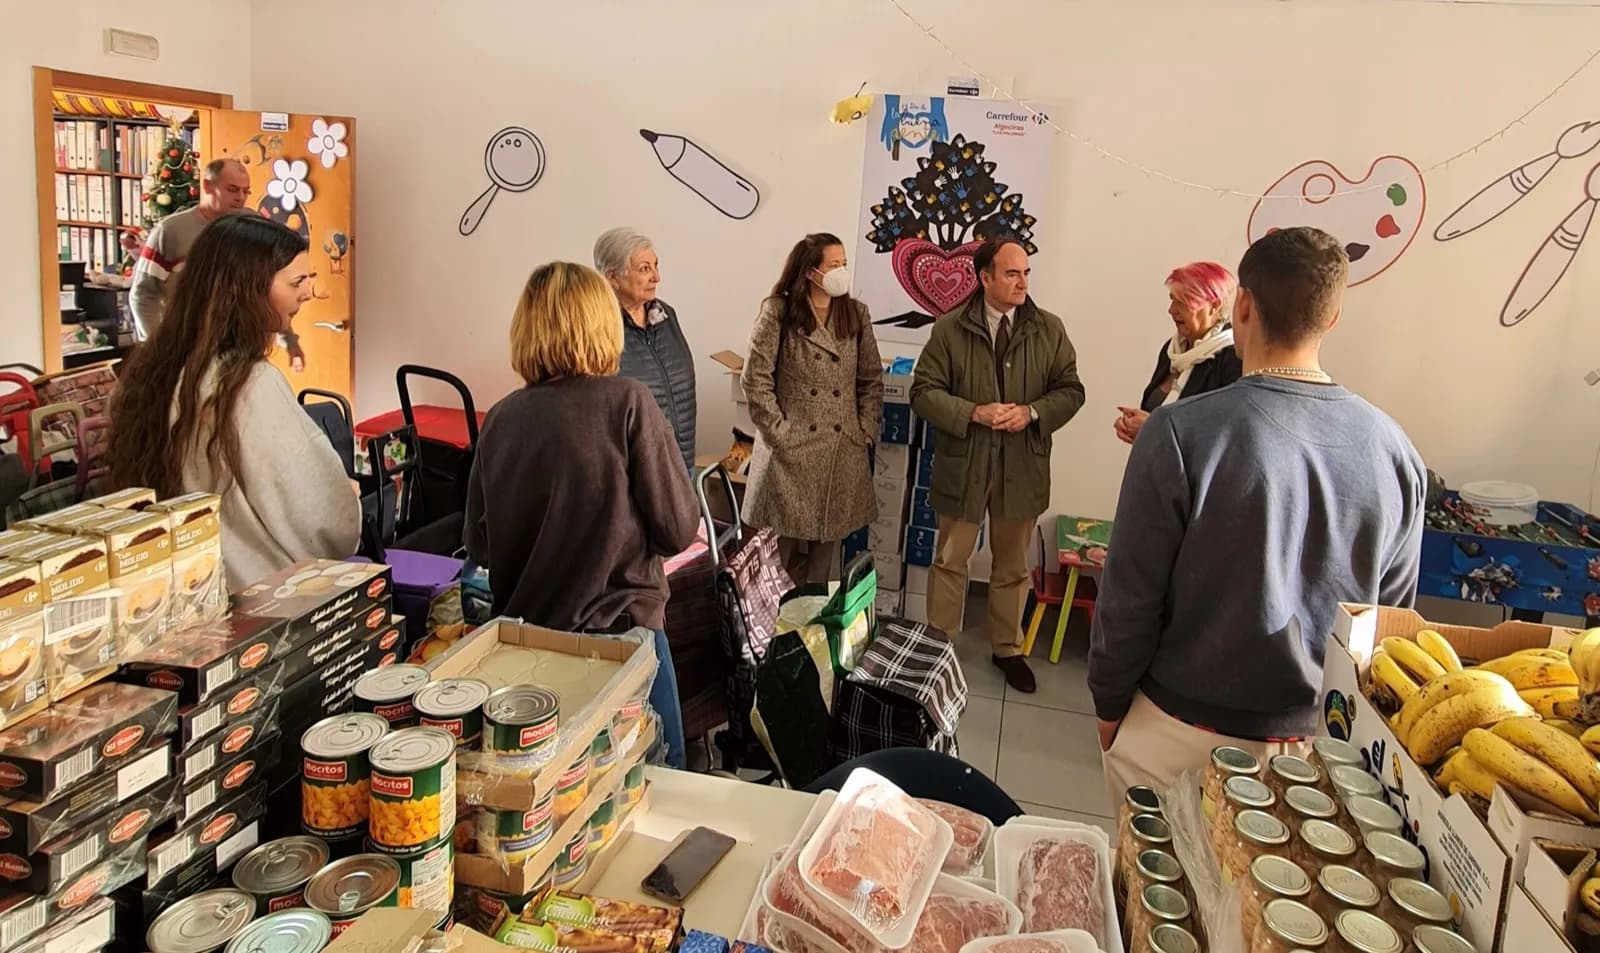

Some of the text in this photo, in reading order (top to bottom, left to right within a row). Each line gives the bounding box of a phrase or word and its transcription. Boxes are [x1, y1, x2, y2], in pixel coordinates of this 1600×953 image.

[986, 111, 1028, 122] Carrefour
[377, 705, 411, 717] mocito
[306, 762, 343, 774] mocitos
[373, 776, 409, 790] mocitos
[273, 895, 303, 910] moci
